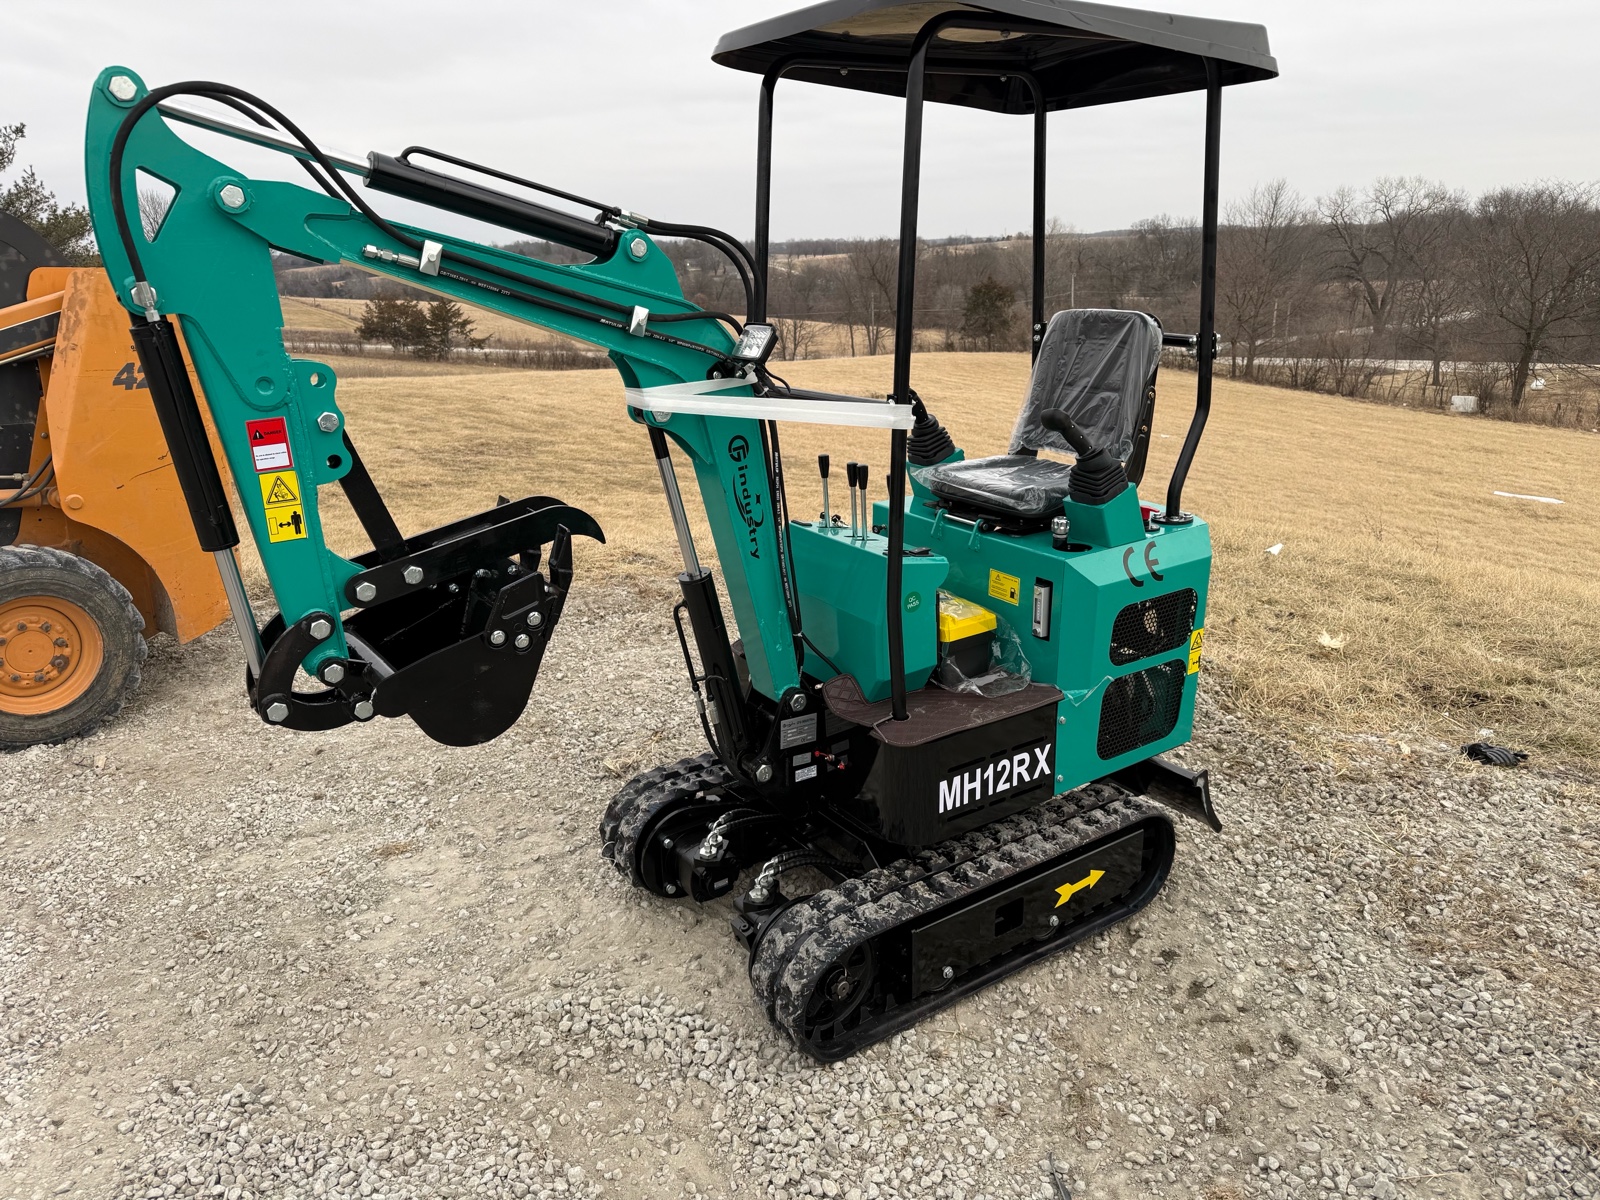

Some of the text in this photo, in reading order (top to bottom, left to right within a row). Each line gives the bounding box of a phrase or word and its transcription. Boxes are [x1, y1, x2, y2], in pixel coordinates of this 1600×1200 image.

[1122, 541, 1165, 587] CE
[906, 599, 920, 610] PASS
[908, 595, 917, 603] QC
[938, 743, 1052, 814] MH12RX
